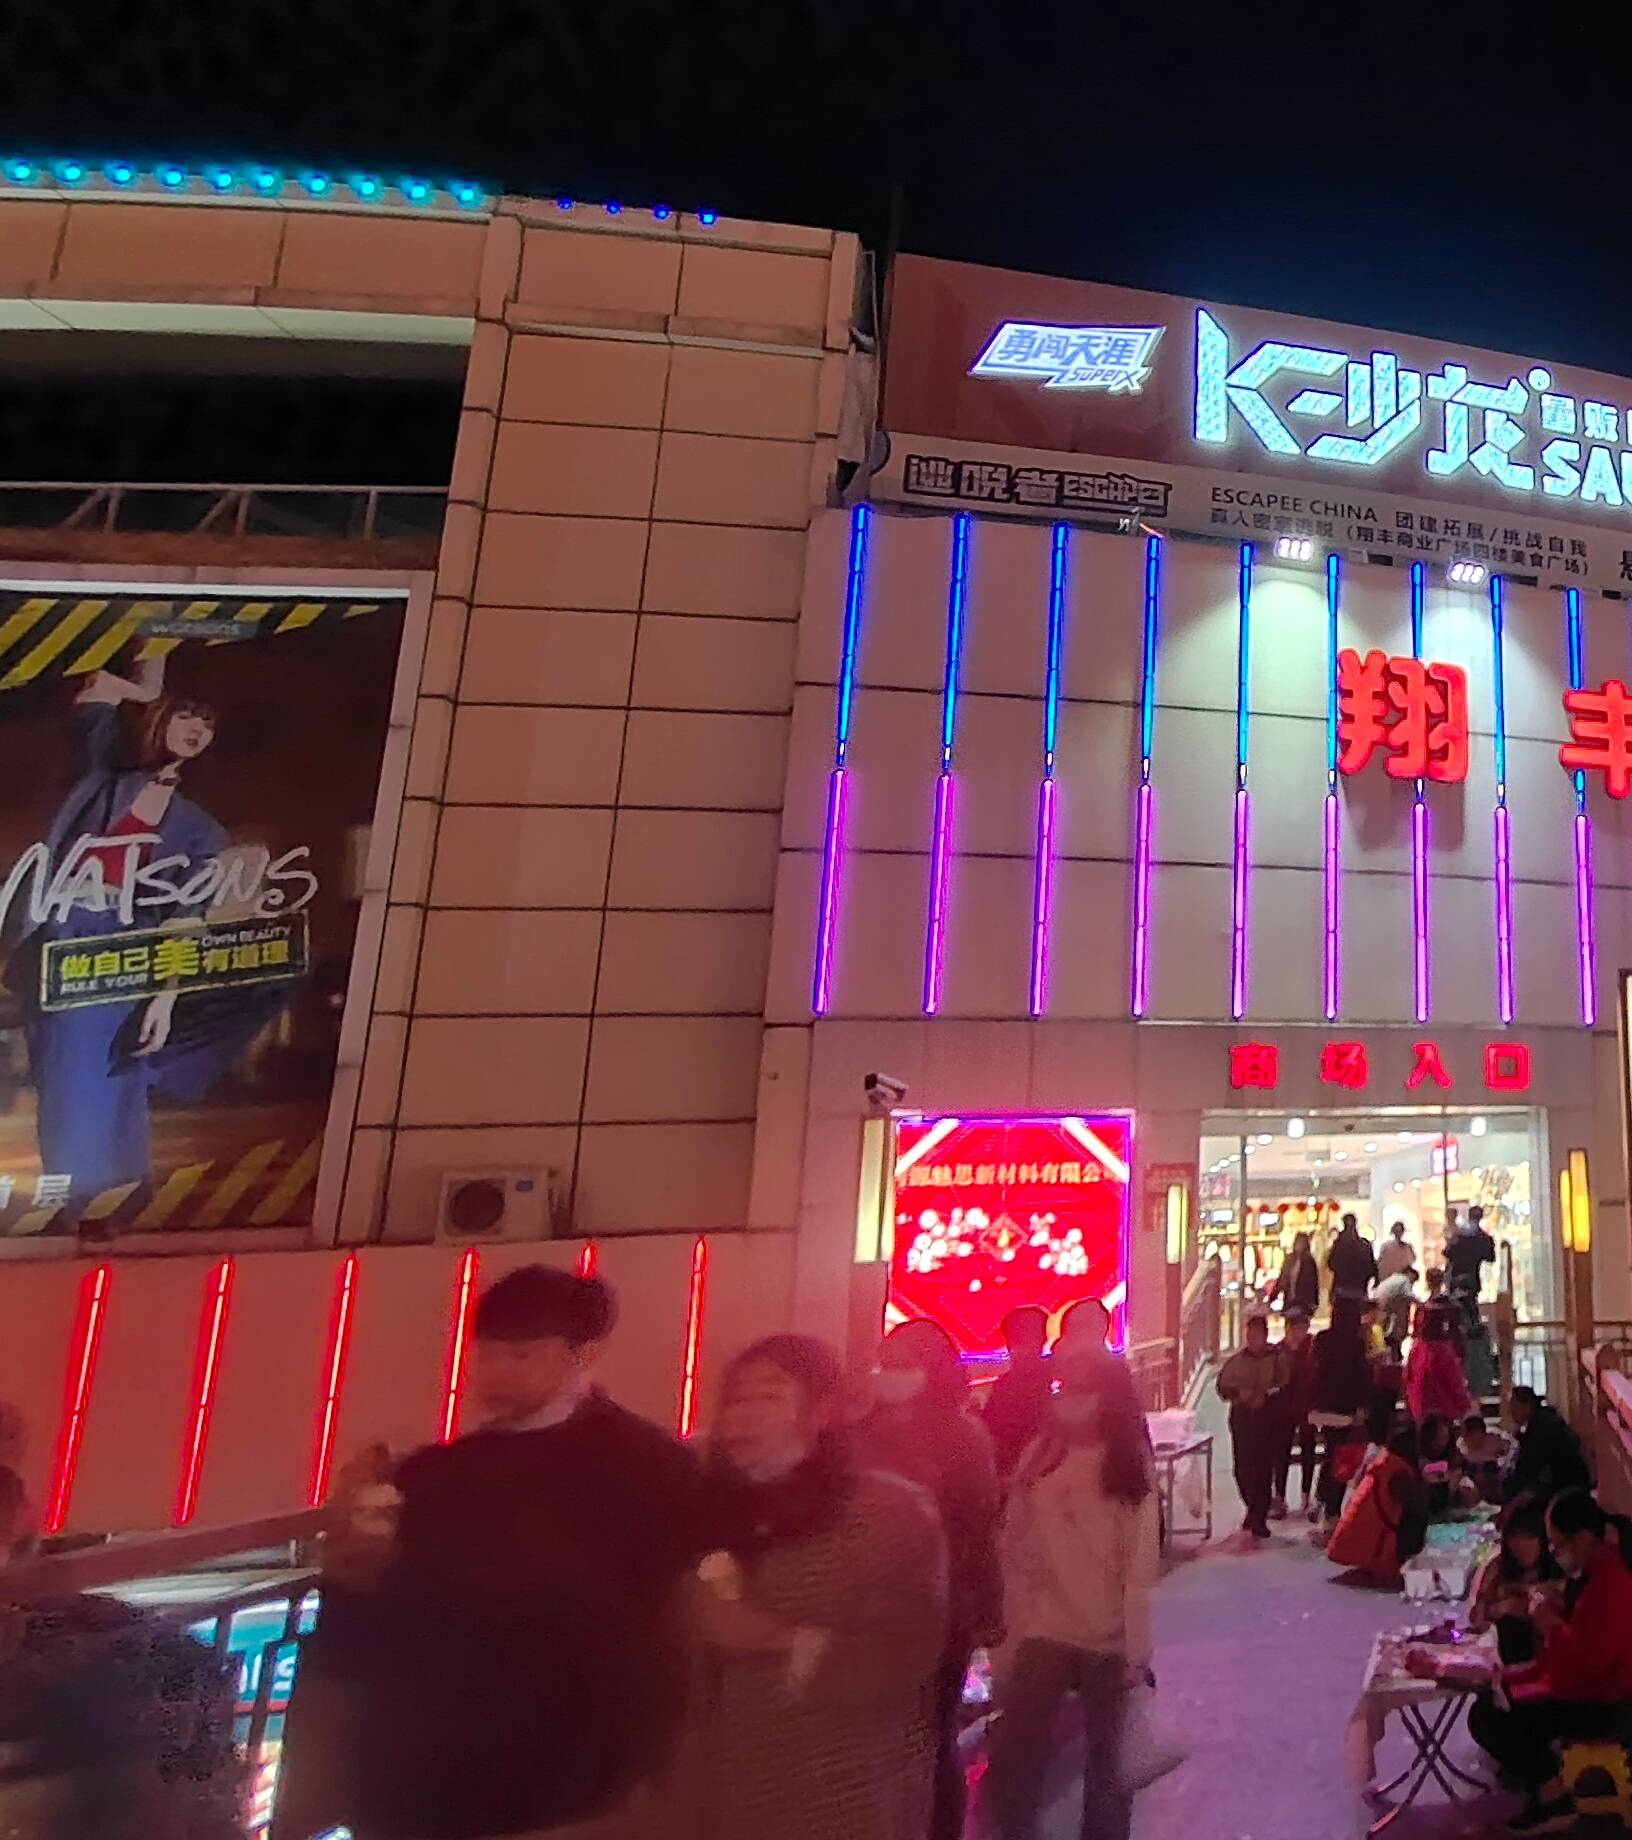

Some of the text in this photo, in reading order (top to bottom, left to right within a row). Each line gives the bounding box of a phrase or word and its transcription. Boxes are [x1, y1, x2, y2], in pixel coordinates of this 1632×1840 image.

[998, 329, 1140, 366] 勇闯天涯
[1211, 487, 1588, 558] ESCAPEE CHINA 团建拓展/挑战自我
[60, 937, 290, 981] 做自己美有道理
[1231, 1042, 1531, 1090] 商场入口
